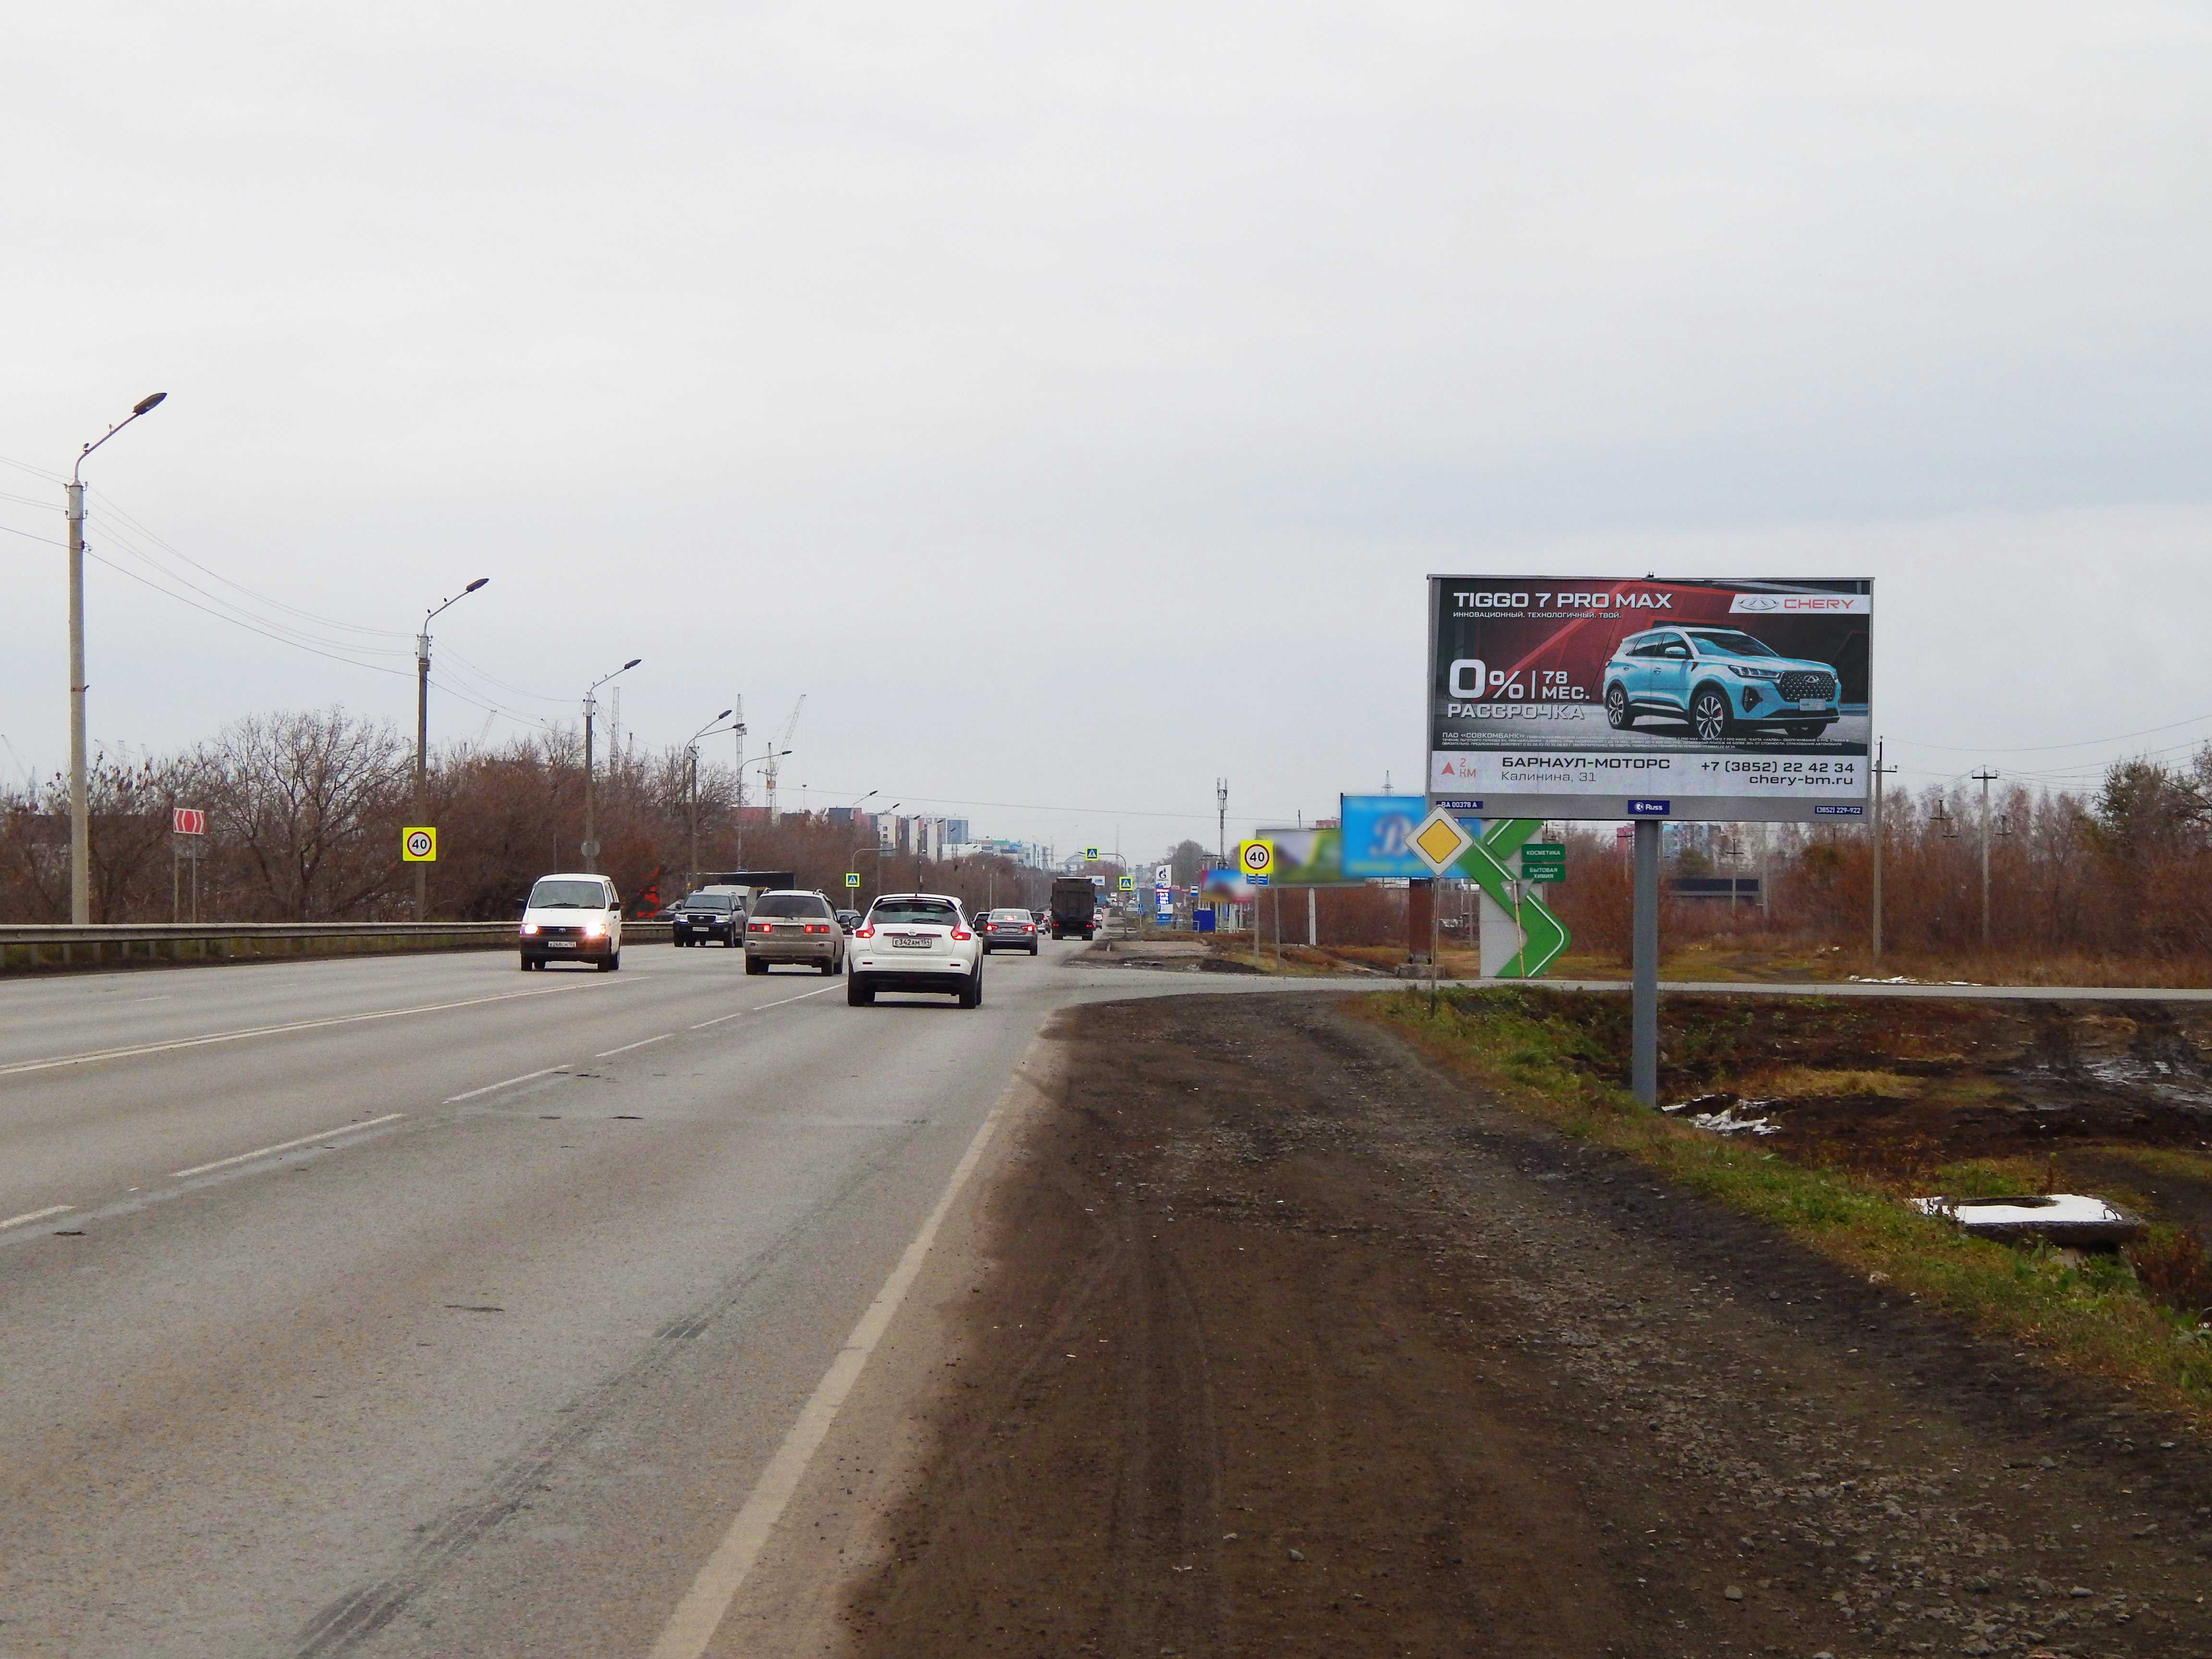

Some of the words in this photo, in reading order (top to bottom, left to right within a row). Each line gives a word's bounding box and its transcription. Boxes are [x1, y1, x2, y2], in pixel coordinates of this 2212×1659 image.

[1453, 592, 1529, 607] TIGGO
[1536, 593, 1551, 608] 7
[1557, 593, 1609, 608] PRO
[1616, 593, 1672, 608] MAX
[1784, 599, 1855, 609] CHERY
[1449, 659, 1524, 699] 0%
[1542, 671, 1568, 685] 78
[1542, 686, 1590, 699] МЕС.
[1447, 704, 1585, 720] РАССРОЧКА
[1460, 758, 1466, 767] 2
[1502, 757, 1670, 769] БАРНАУЛ-МОТОРС
[1701, 761, 1719, 771] +7
[1725, 761, 1777, 773] (3852)
[1783, 763, 1802, 772] 22
[1808, 763, 1828, 772] 42
[1834, 763, 1854, 773] 34
[1460, 769, 1476, 778] КМ
[1502, 771, 1574, 782] Калинина,
[1579, 772, 1597, 781] 31
[1749, 775, 1853, 785] chery-bm.ru
[412, 839, 427, 849] 40
[1250, 852, 1265, 862] 40
